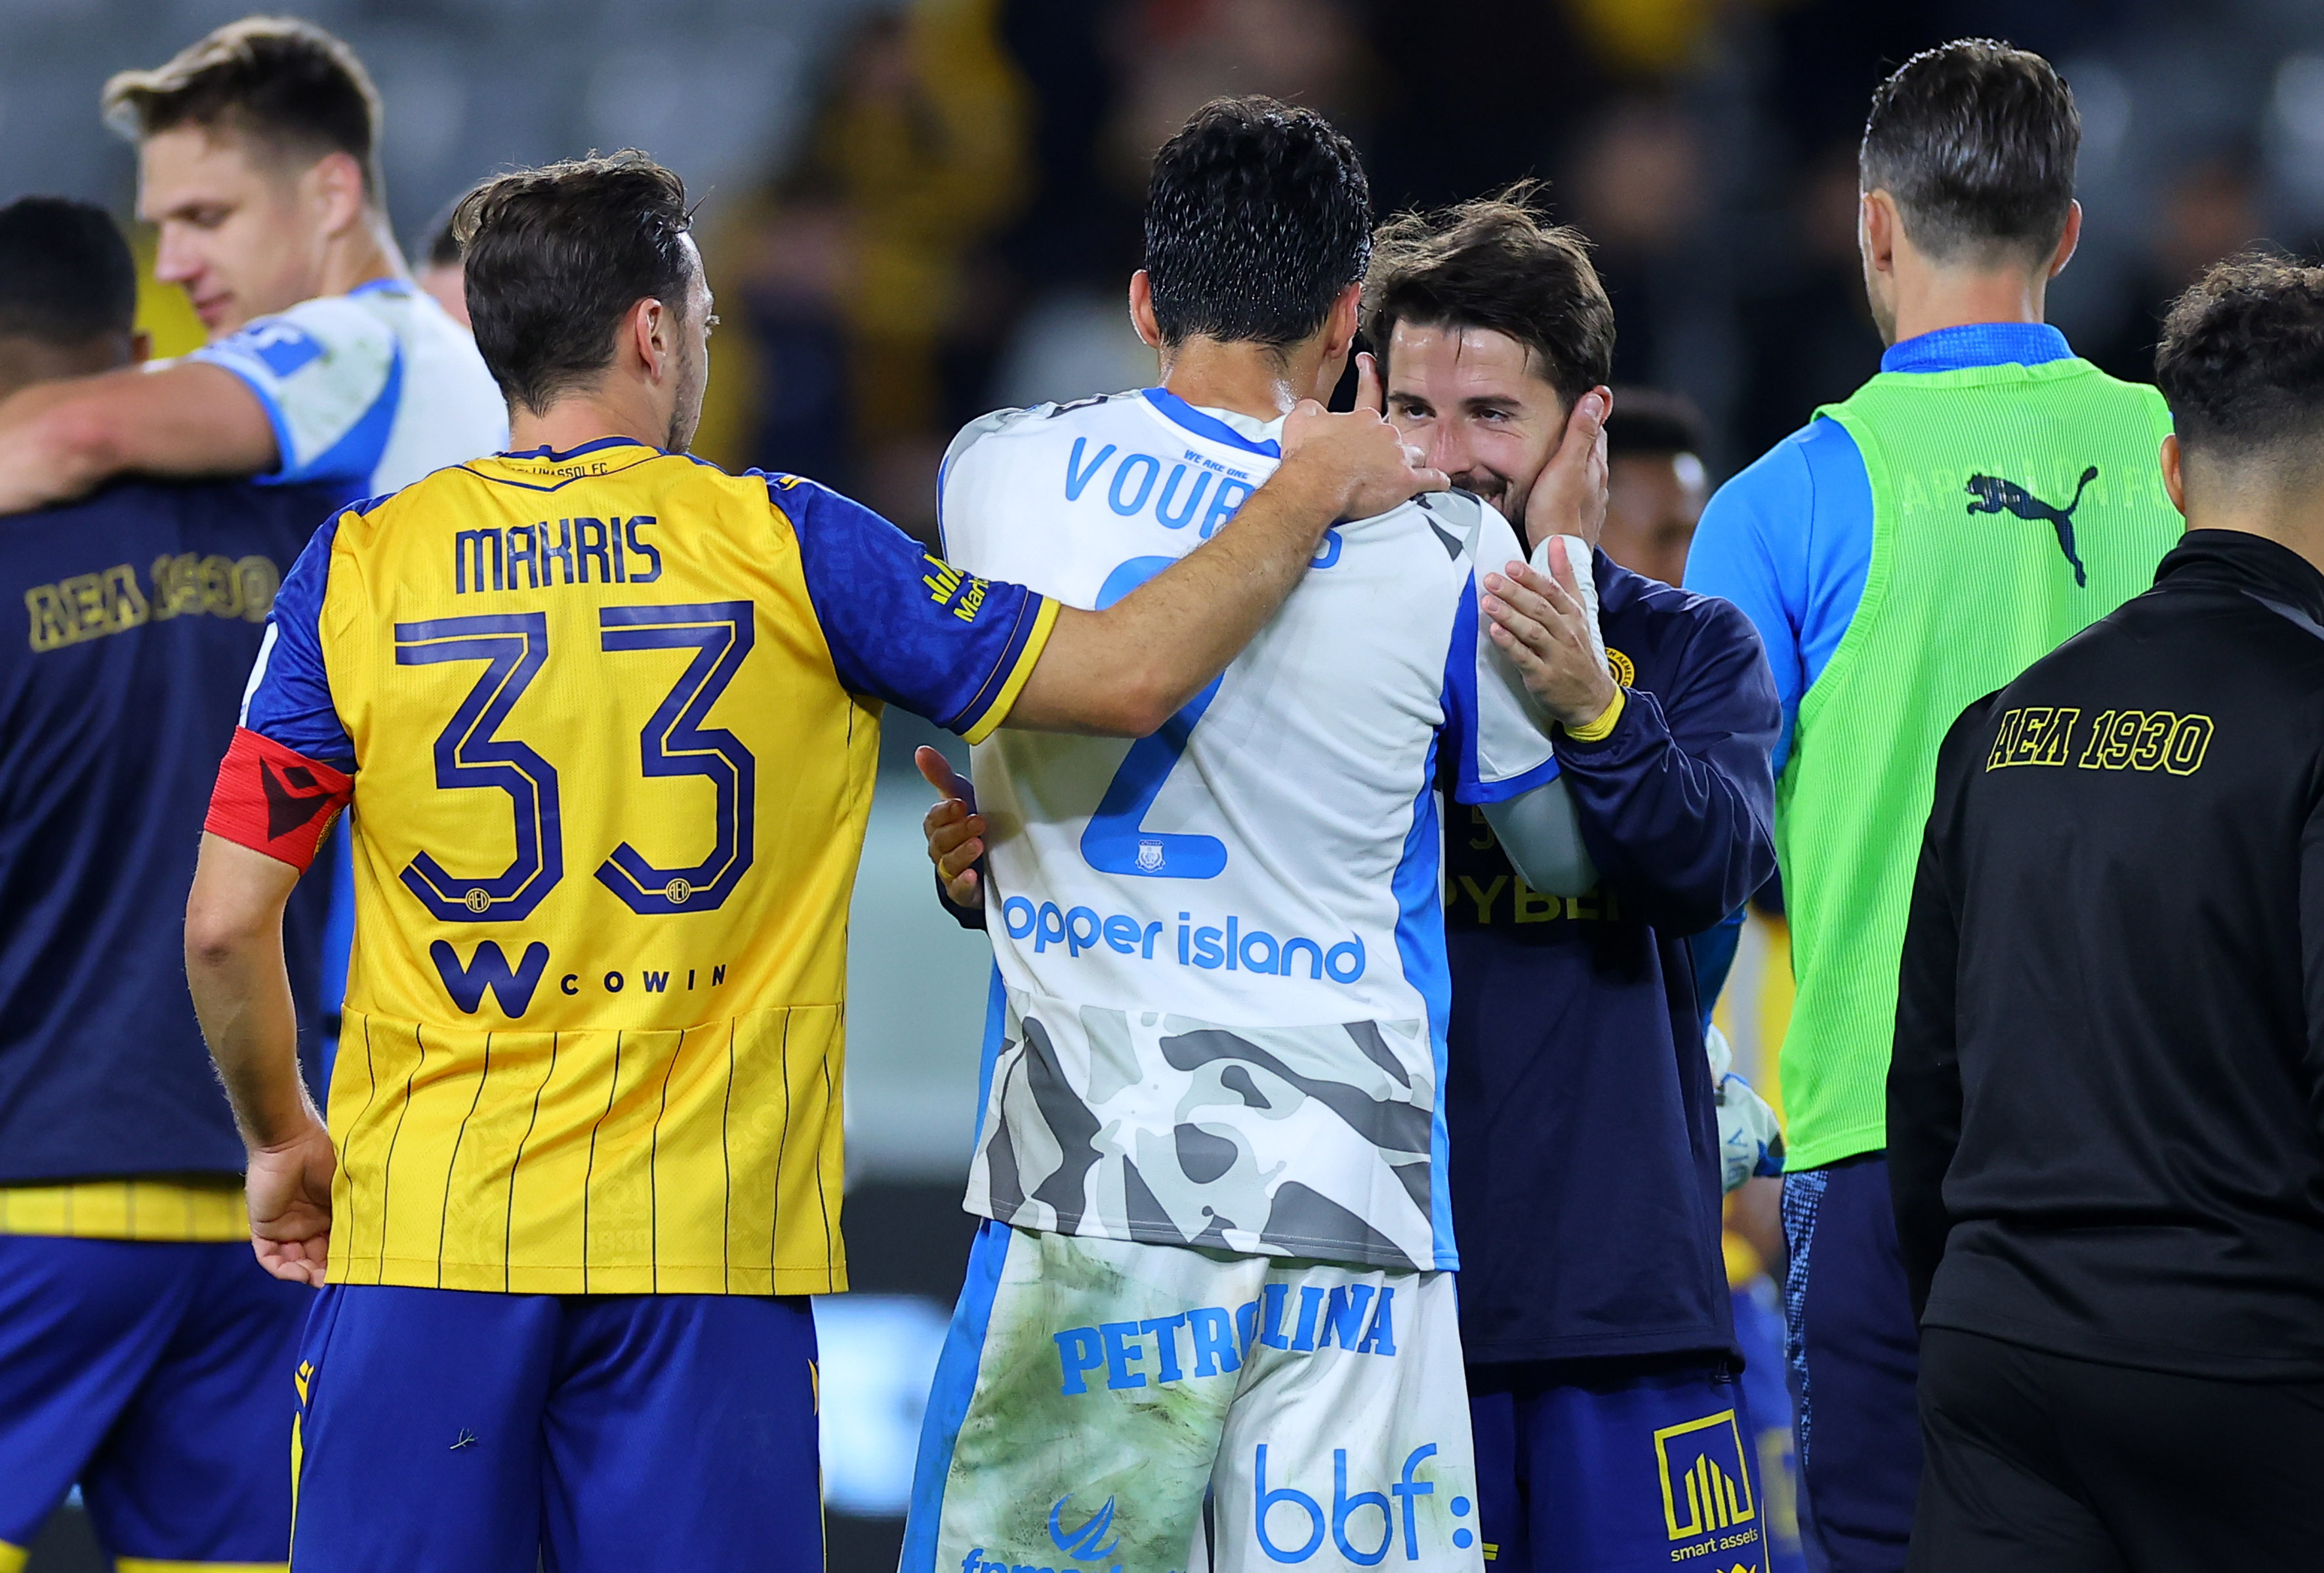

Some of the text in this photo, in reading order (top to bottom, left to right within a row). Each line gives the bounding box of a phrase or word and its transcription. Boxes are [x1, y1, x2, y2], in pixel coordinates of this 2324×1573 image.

[592, 462, 607, 474] FC
[1184, 450, 1250, 479] WE ARE ONE
[151, 552, 279, 623] 1930
[456, 516, 662, 594] MAKRIS
[394, 600, 755, 922] 33
[2078, 710, 2214, 776] 1930
[1003, 895, 1366, 984] opper island
[561, 964, 726, 995] COWIN
[1671, 1528, 1759, 1562] smart assets
